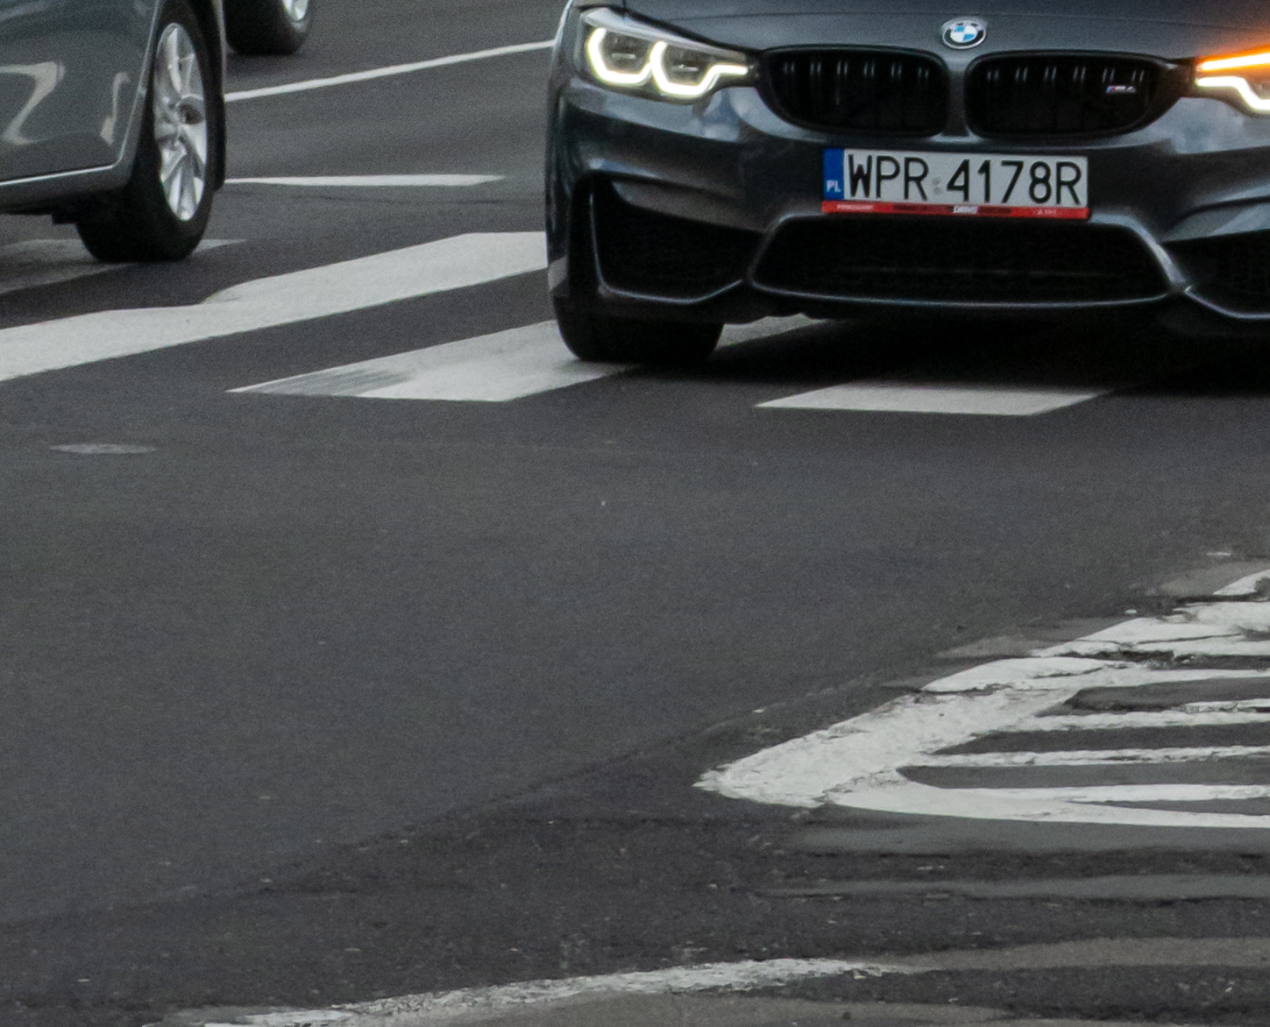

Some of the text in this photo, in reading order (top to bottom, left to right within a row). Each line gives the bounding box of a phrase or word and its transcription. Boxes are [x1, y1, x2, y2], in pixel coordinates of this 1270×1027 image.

[825, 179, 842, 193] PL
[847, 153, 1083, 206] WPR 4178R
